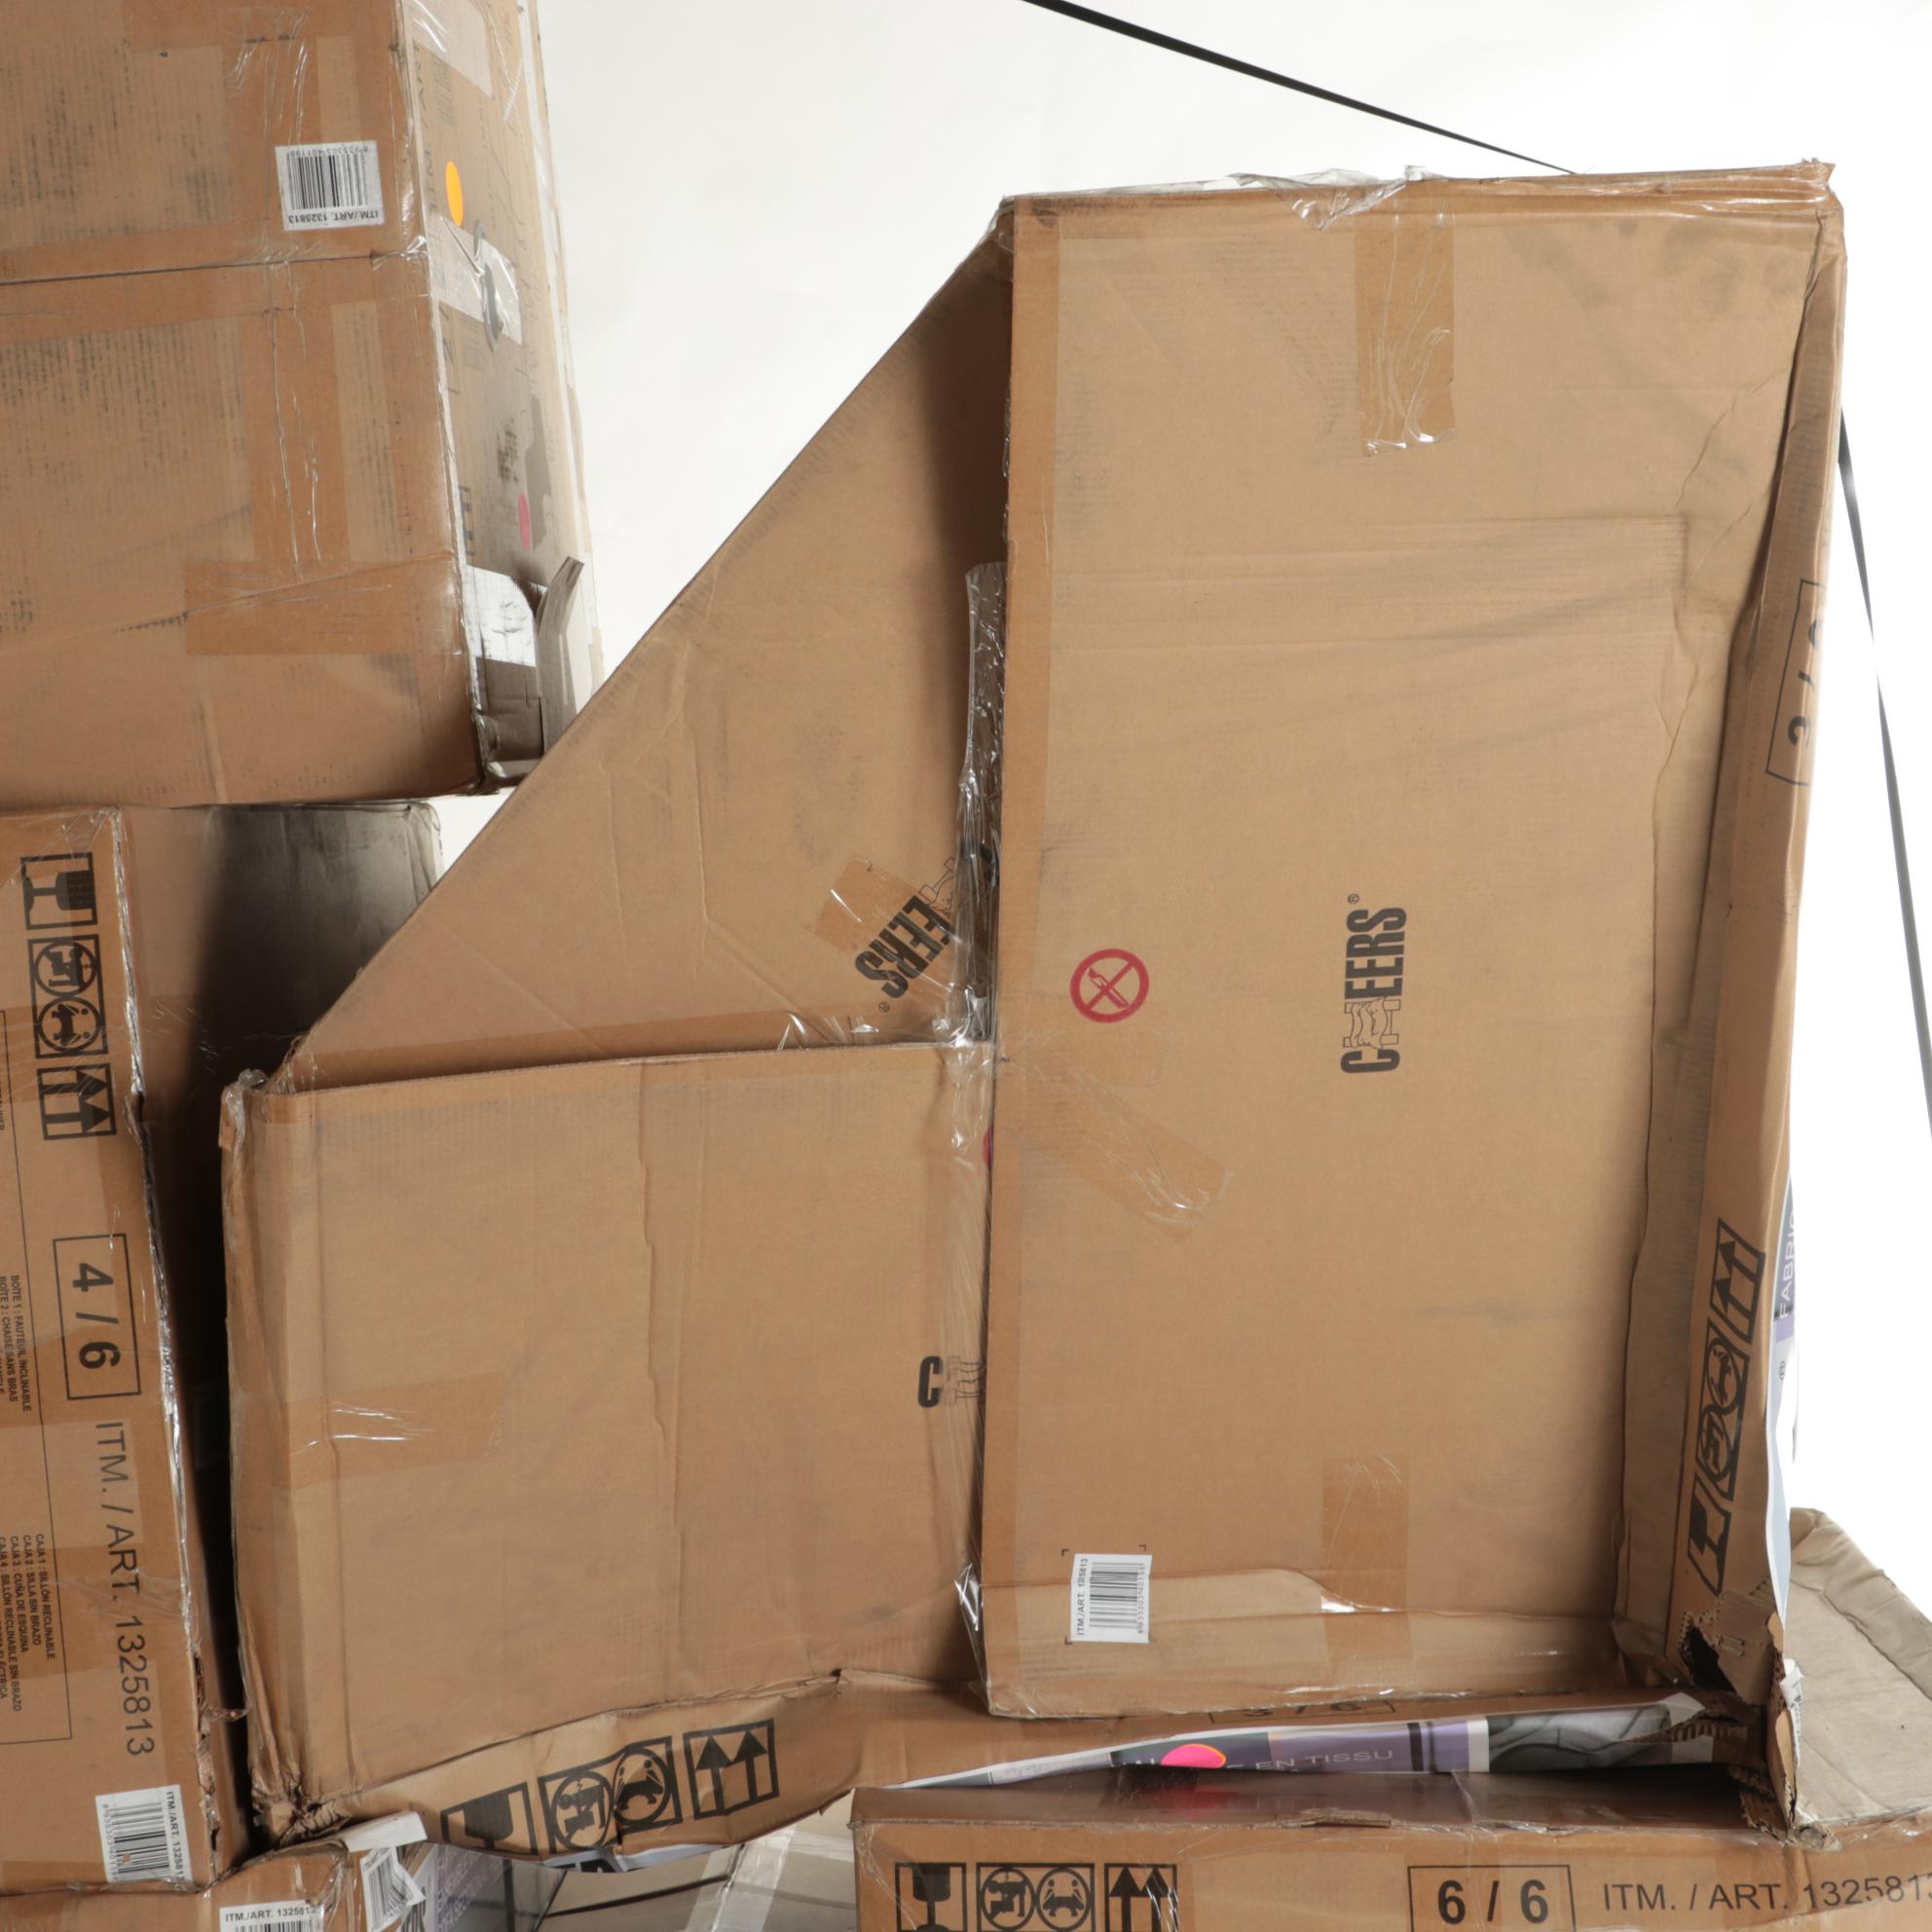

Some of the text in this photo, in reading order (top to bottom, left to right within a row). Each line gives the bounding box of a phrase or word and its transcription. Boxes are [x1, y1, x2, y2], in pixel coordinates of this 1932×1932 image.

[288, 214, 327, 224] 1325813
[73, 1262, 114, 1292] 4
[2, 1317, 14, 1350] CHAISE
[15, 1316, 26, 1357] FAUTEUIL
[6, 1352, 16, 1375] SANS
[79, 1341, 121, 1369] 6
[8, 1377, 19, 1402] BRAS
[19, 1359, 32, 1412] INCLINABLE
[95, 1422, 129, 1493] ITM.
[11, 1536, 20, 1558] CAJA
[23, 1535, 33, 1558] CAJA
[36, 1534, 47, 1557] CAJA
[106, 1524, 141, 1602] ART.
[1, 1574, 12, 1606] SILLÓN
[14, 1573, 24, 1598] CUÑA
[26, 1572, 36, 1597] SILLA
[39, 1571, 51, 1602] SILLÓN
[17, 1600, 24, 1611] DE
[29, 1599, 38, 1613] SIN
[5, 1607, 17, 1662] RECLINABLE
[18, 1613, 29, 1653] ESQUINA
[31, 1615, 42, 1646] BRAZO
[42, 1604, 56, 1659] RECLINABLE
[9, 1663, 19, 1679] SIN
[116, 1616, 155, 1755] 1325813
[11, 1681, 21, 1712] BRAZO
[1256, 1750, 1393, 1770] EN TISSU
[1437, 1879, 1466, 1924] 6
[1521, 1879, 1548, 1923] 6
[1604, 1883, 1676, 1912] ITM.
[1709, 1883, 1788, 1911] ART.
[1803, 1874, 1932, 1909] 132581
